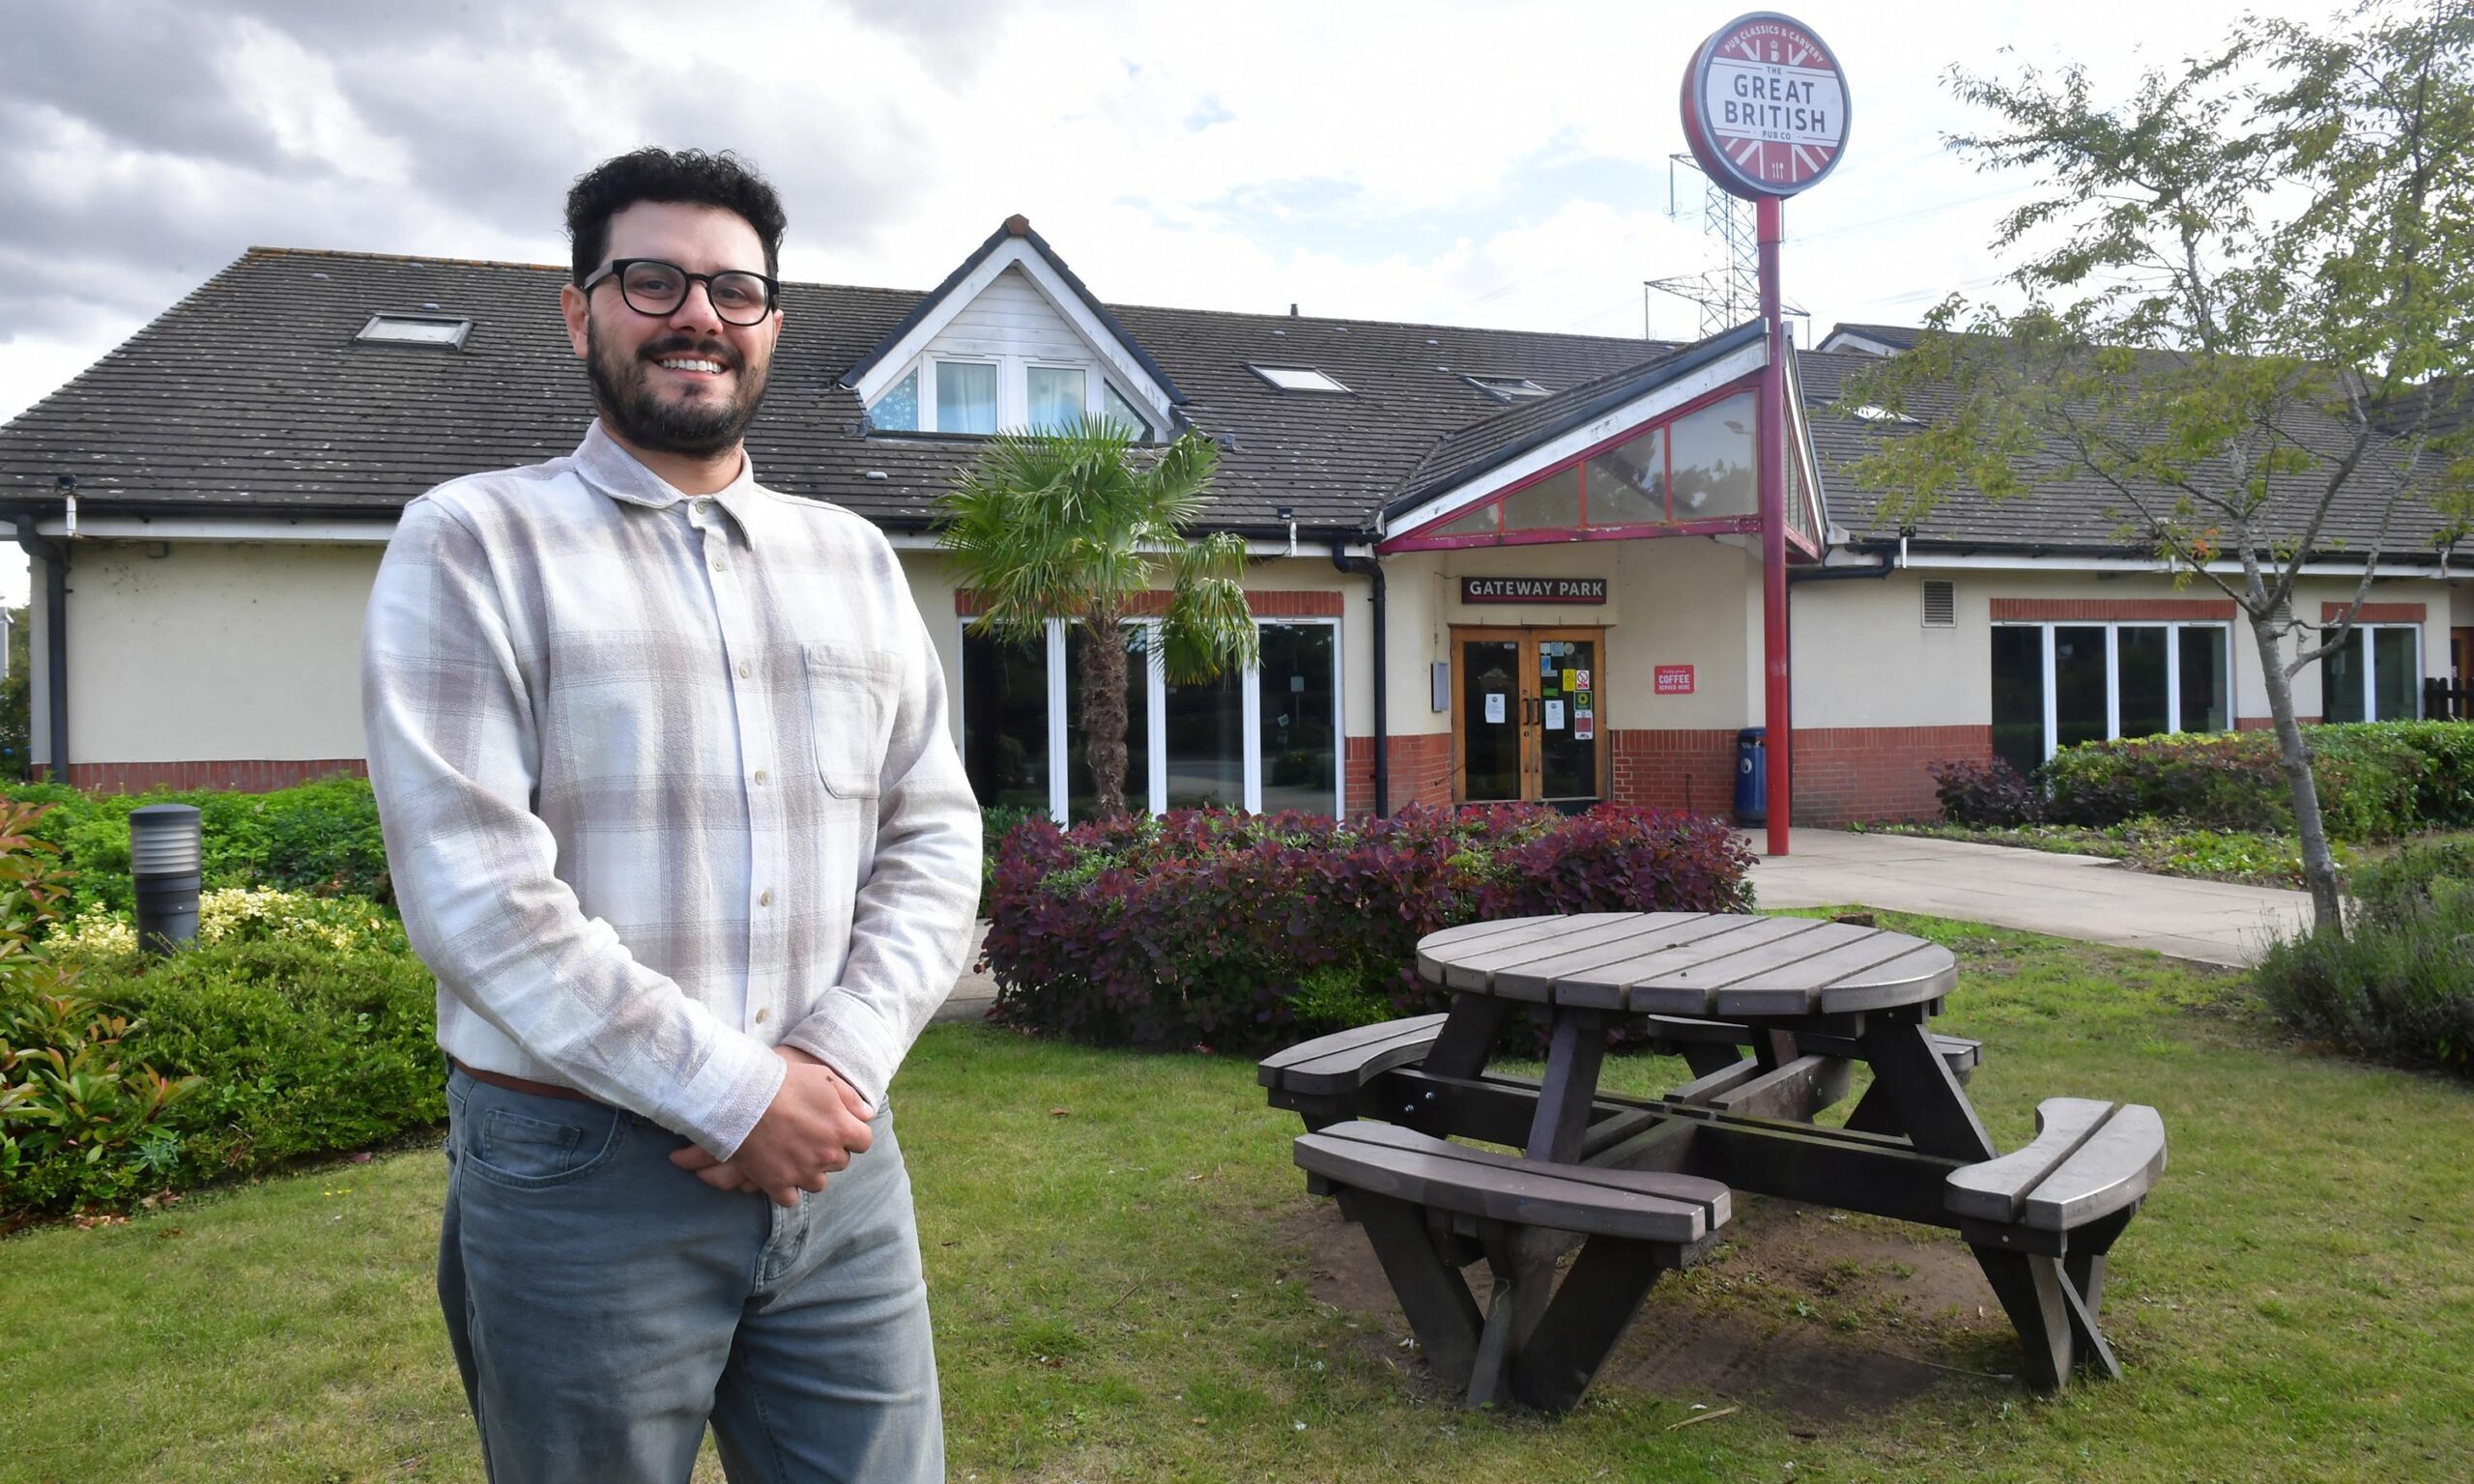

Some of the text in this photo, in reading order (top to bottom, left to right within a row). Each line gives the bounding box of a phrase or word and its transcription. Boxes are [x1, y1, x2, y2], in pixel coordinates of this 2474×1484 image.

[1724, 25, 1824, 62] PUB CLASSICS & CARVERY
[1734, 74, 1814, 103] GREAT
[1725, 100, 1825, 132] BRITISH
[1762, 130, 1791, 140] PUB CO
[1469, 581, 1602, 596] GATEWAY PARK
[1658, 674, 1689, 684] COFFEE
